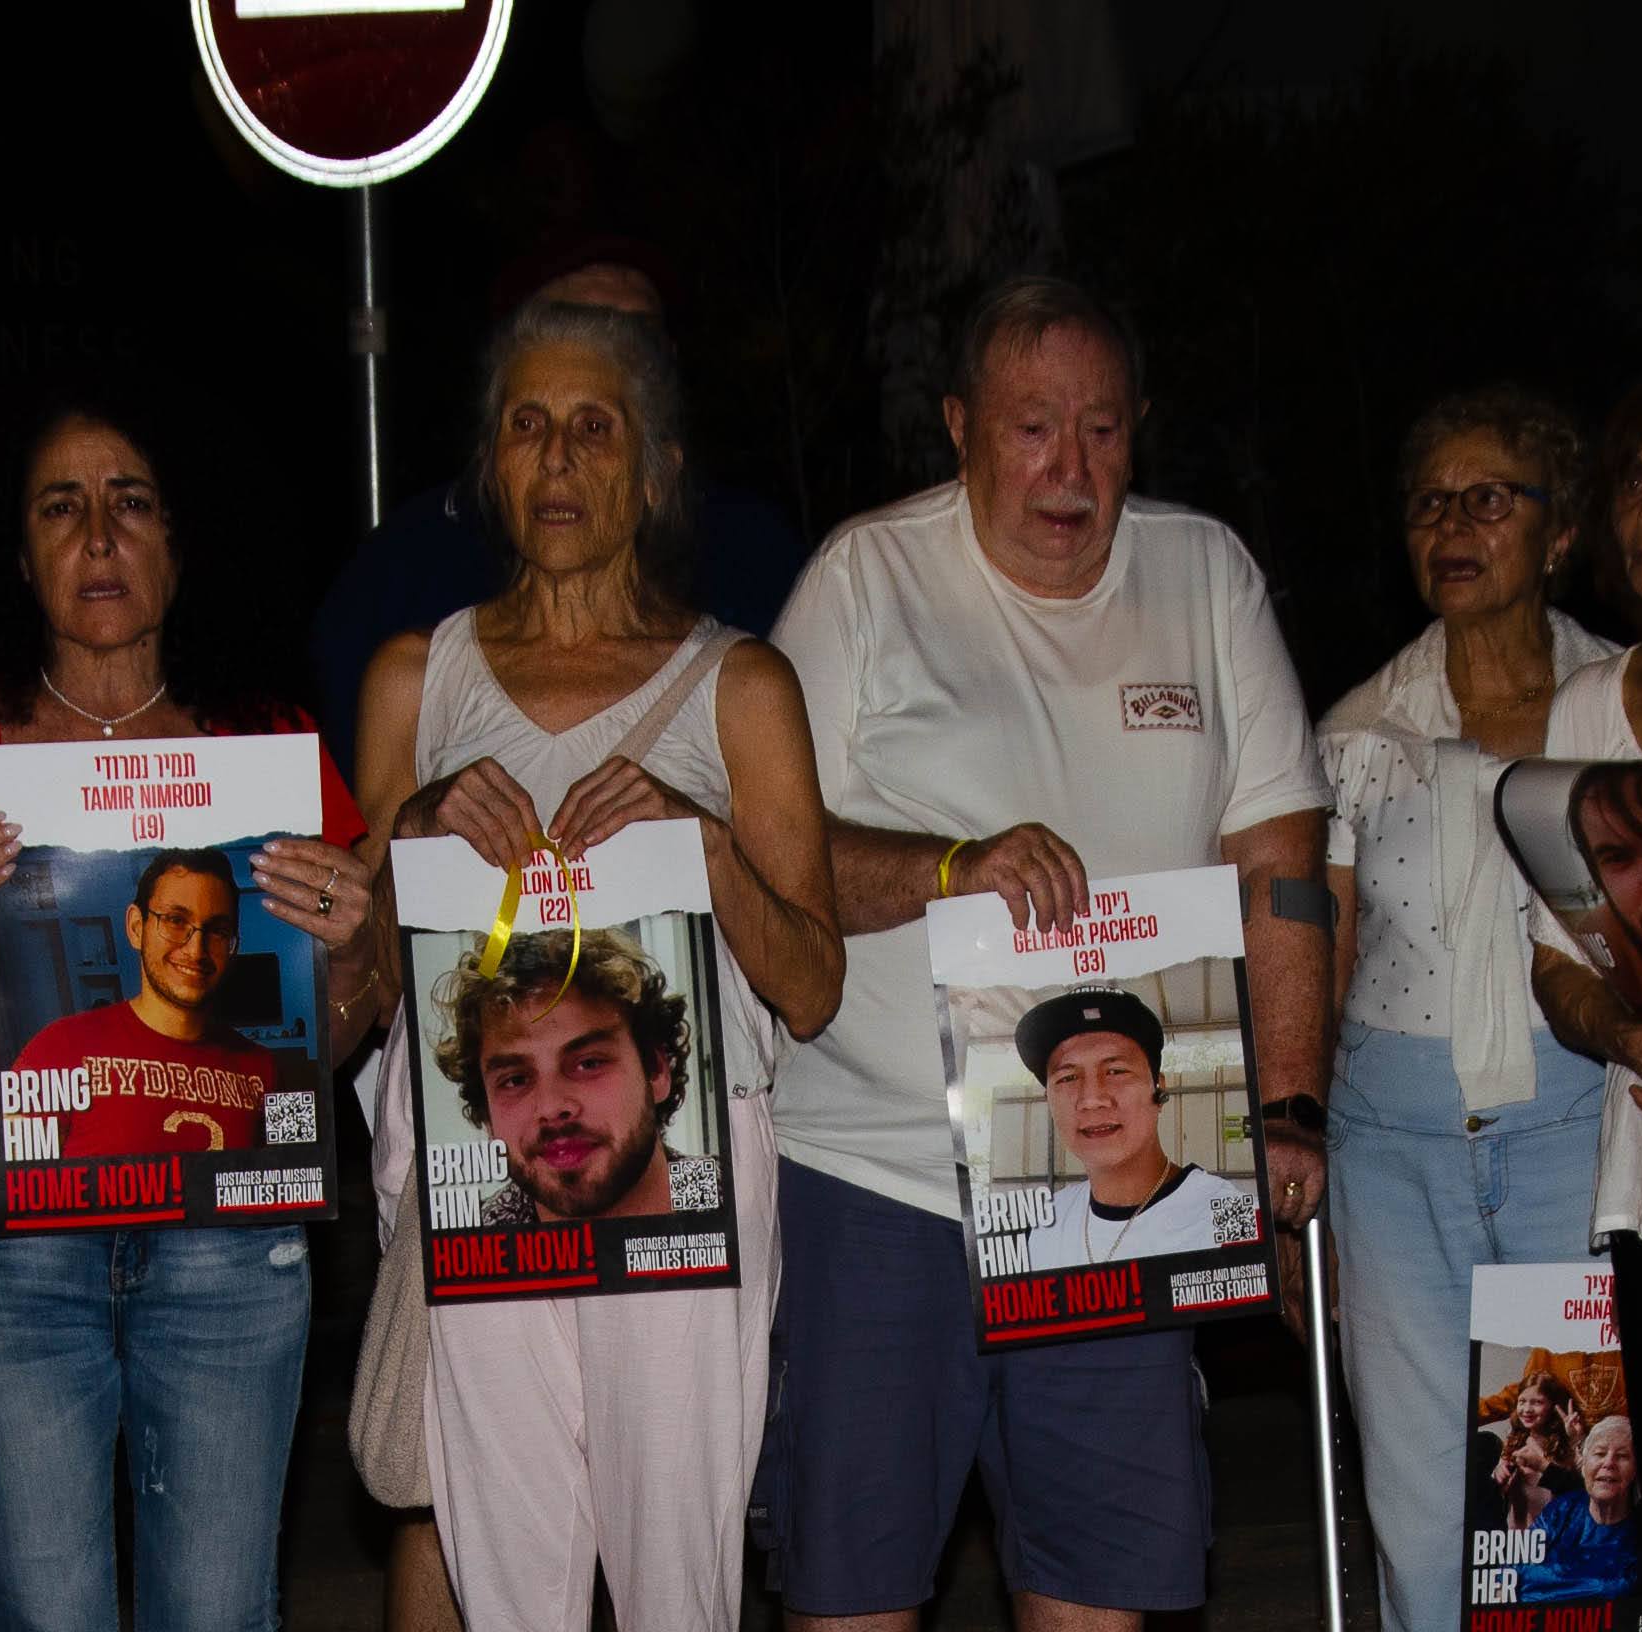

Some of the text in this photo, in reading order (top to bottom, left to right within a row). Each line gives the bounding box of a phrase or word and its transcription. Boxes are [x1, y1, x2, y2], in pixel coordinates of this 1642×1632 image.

[95, 752, 196, 779] תמיר נמרודי
[81, 782, 211, 812] TAMIR NIMRODI
[132, 813, 165, 842] (19)
[540, 898, 571, 924] (22)
[1089, 915, 1158, 946] PACHECO
[1073, 951, 1106, 976] (33)
[1, 1068, 91, 1114] BRING
[3, 1116, 60, 1162] HIM
[215, 1167, 322, 1186] HOSTAGES AND MISSING
[429, 1139, 508, 1187] BRING
[6, 1155, 182, 1214] HOME NOW!
[215, 1182, 323, 1207] FAMILIES FORUM
[430, 1188, 482, 1230] HIM
[973, 1186, 1055, 1235] BRING
[431, 1221, 596, 1280] HOME NOW!
[625, 1233, 725, 1252] HOSTAGES AND MISSING
[977, 1233, 1031, 1279] HIM
[626, 1247, 727, 1274] FAMILIES FORUM
[1170, 1263, 1266, 1287] HOSTAGES AND MISSING
[982, 1260, 1145, 1327] HOME NOW!
[1171, 1277, 1268, 1308] FAMILIES FORUM
[1564, 1299, 1612, 1320] CHANA
[1472, 1528, 1547, 1567] BRING
[1471, 1567, 1520, 1605] HER
